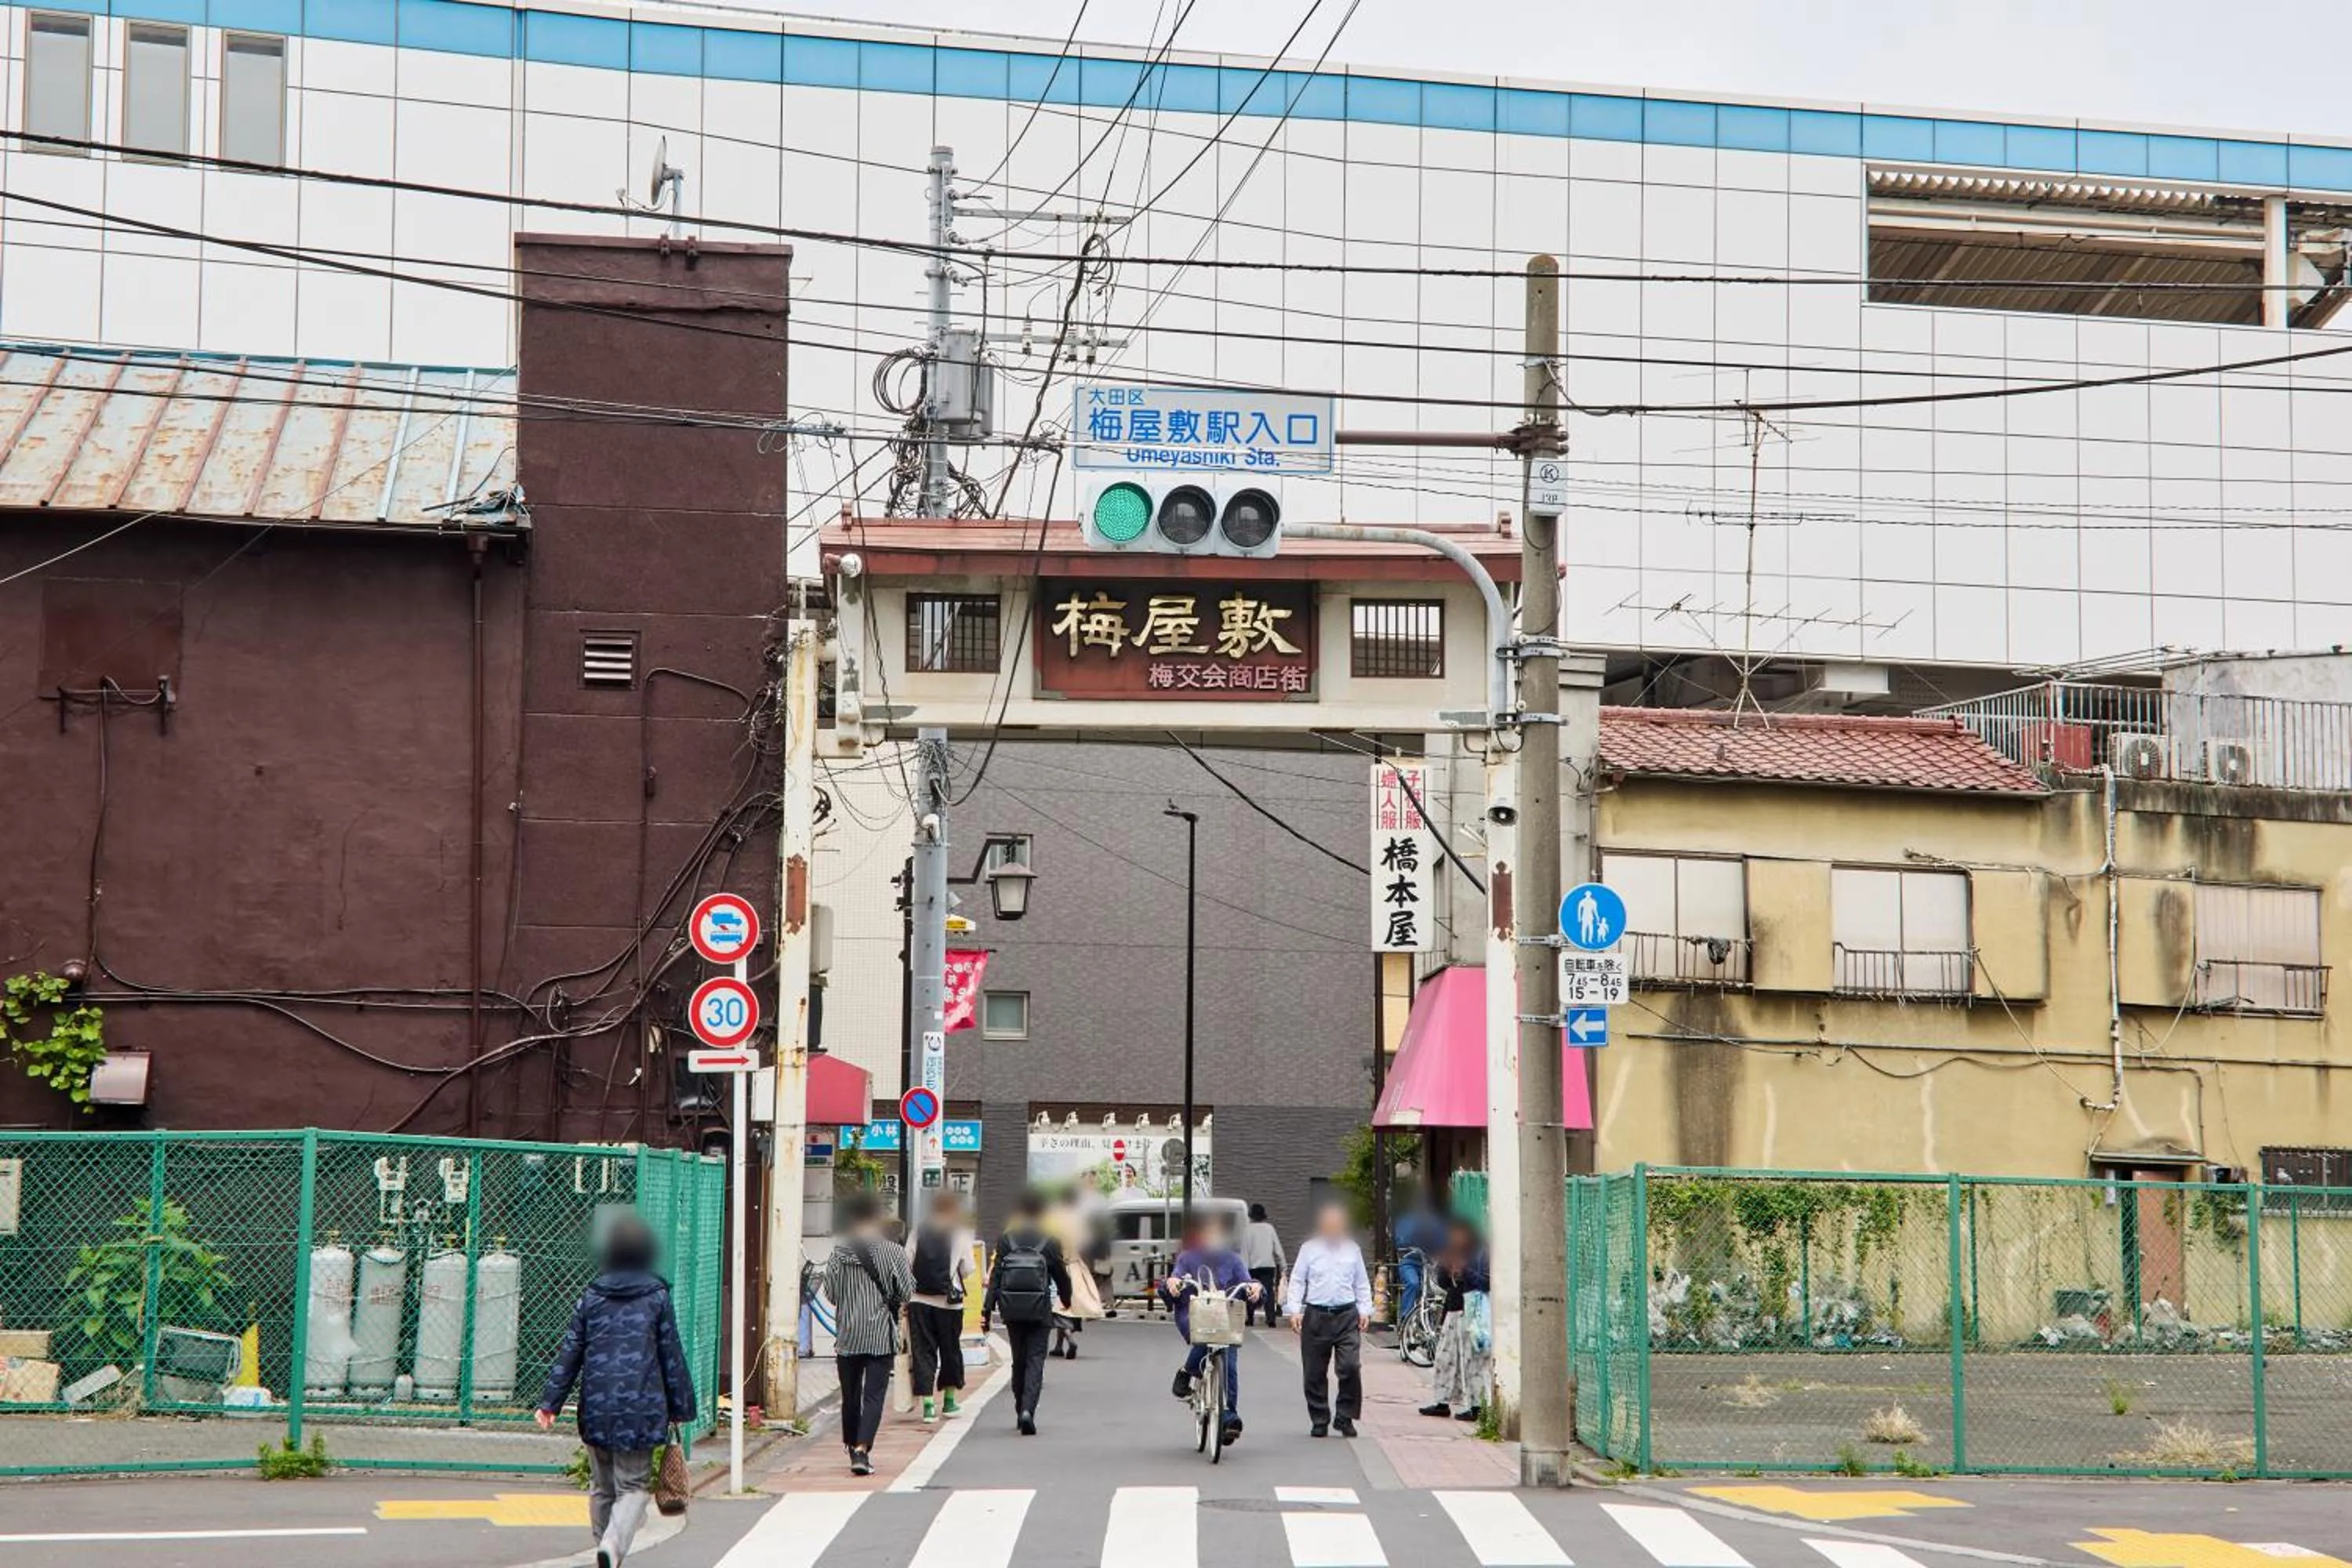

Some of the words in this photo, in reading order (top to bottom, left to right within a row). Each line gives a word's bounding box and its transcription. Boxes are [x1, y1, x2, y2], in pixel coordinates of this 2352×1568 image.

[1087, 388, 1145, 406] 大田区
[1087, 407, 1319, 445] 梅屋敷駅入口
[1127, 448, 1236, 466] Umeyashiki
[1244, 448, 1281, 466] Sta.
[1051, 590, 1303, 659] 梅屋敷
[1148, 662, 1308, 693] 梅交会商店街
[1380, 836, 1421, 948] 橋本屋
[1564, 958, 1623, 972] 自転車を除く
[706, 997, 743, 1027] 30
